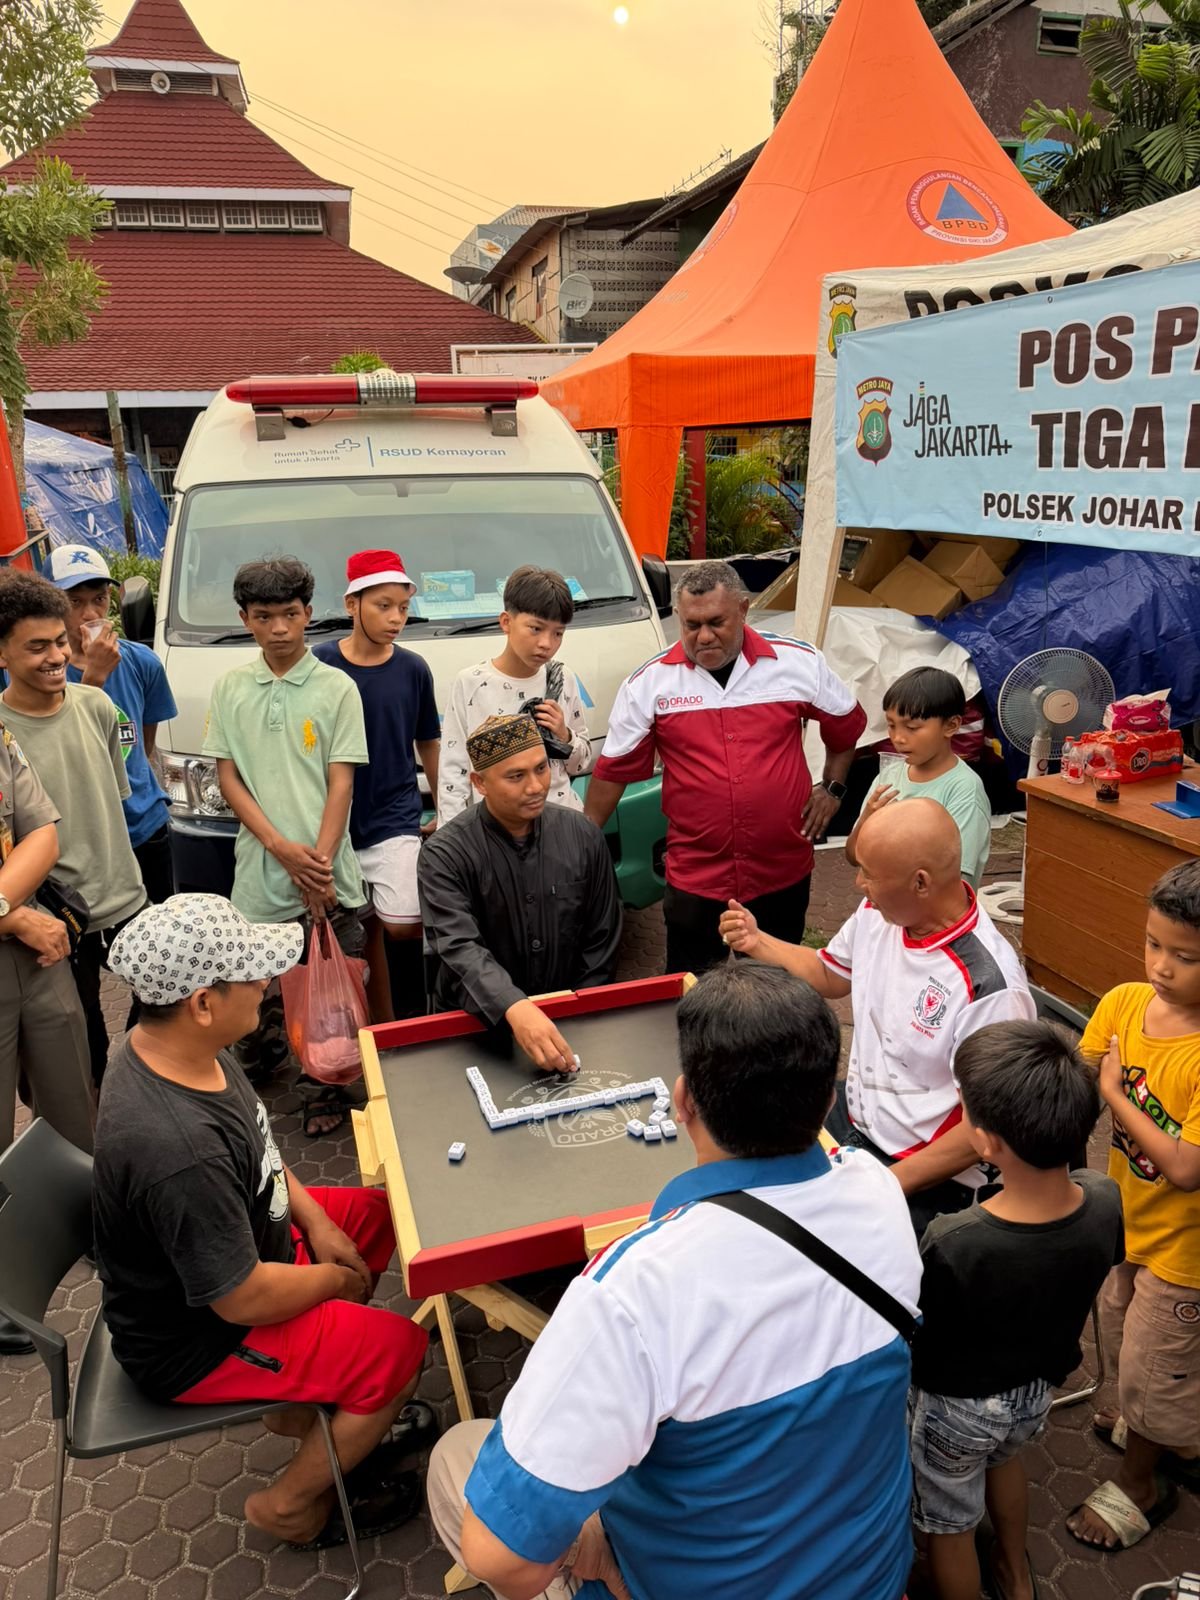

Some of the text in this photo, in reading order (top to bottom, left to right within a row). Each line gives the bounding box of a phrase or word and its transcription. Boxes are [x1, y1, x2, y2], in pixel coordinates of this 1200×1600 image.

[942, 219, 989, 231] BPBD
[1019, 306, 1200, 389] POS P
[858, 379, 892, 395] METRO JAYA
[903, 393, 952, 427] JAGA
[1031, 405, 1166, 469] TIGA
[274, 449, 308, 458] Rumah
[303, 455, 341, 463] Jakarta
[380, 447, 506, 457] RSUD Kemayoran
[983, 492, 1075, 522] POLSEK
[1082, 496, 1184, 531] JOHAR
[556, 1122, 628, 1145] ORADO
